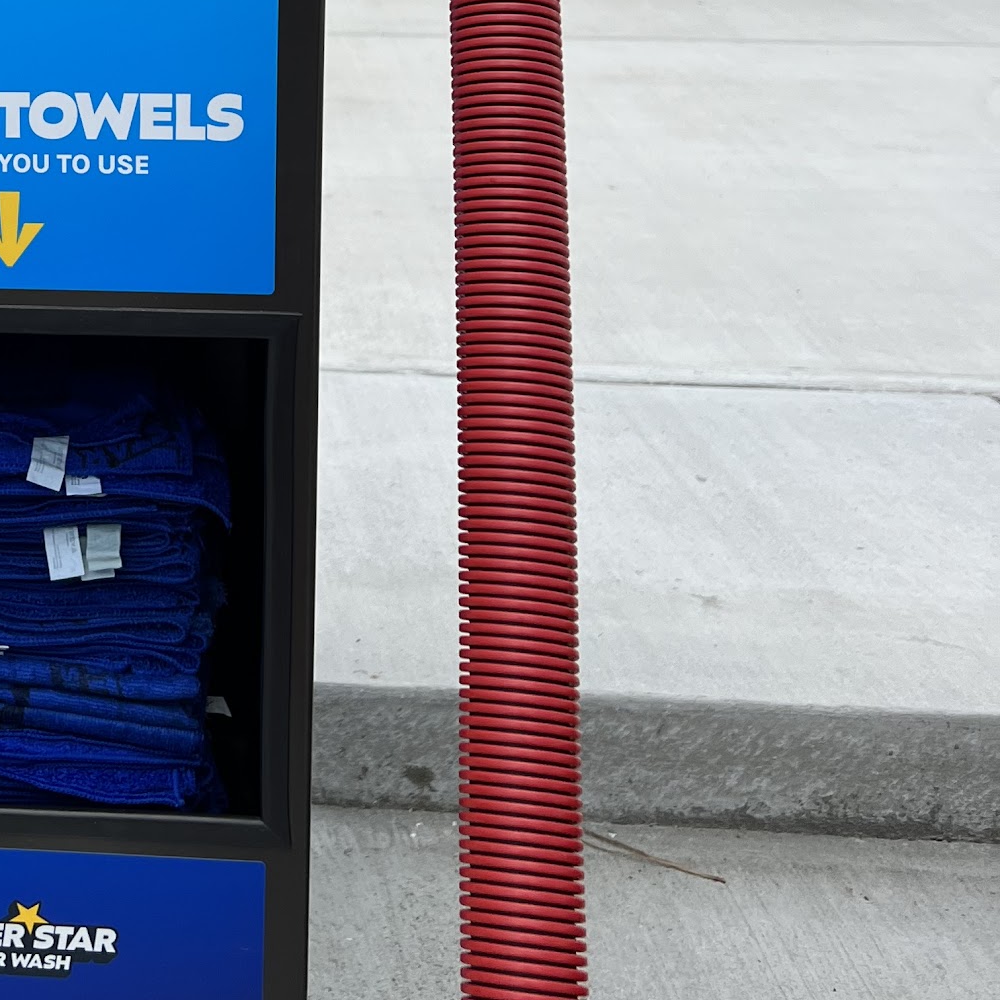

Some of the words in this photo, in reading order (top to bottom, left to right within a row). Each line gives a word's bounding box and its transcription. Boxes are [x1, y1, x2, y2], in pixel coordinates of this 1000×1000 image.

[57, 154, 91, 174] TO
[98, 154, 149, 175] USE
[32, 924, 117, 953] STAR
[11, 952, 71, 971] WASH
